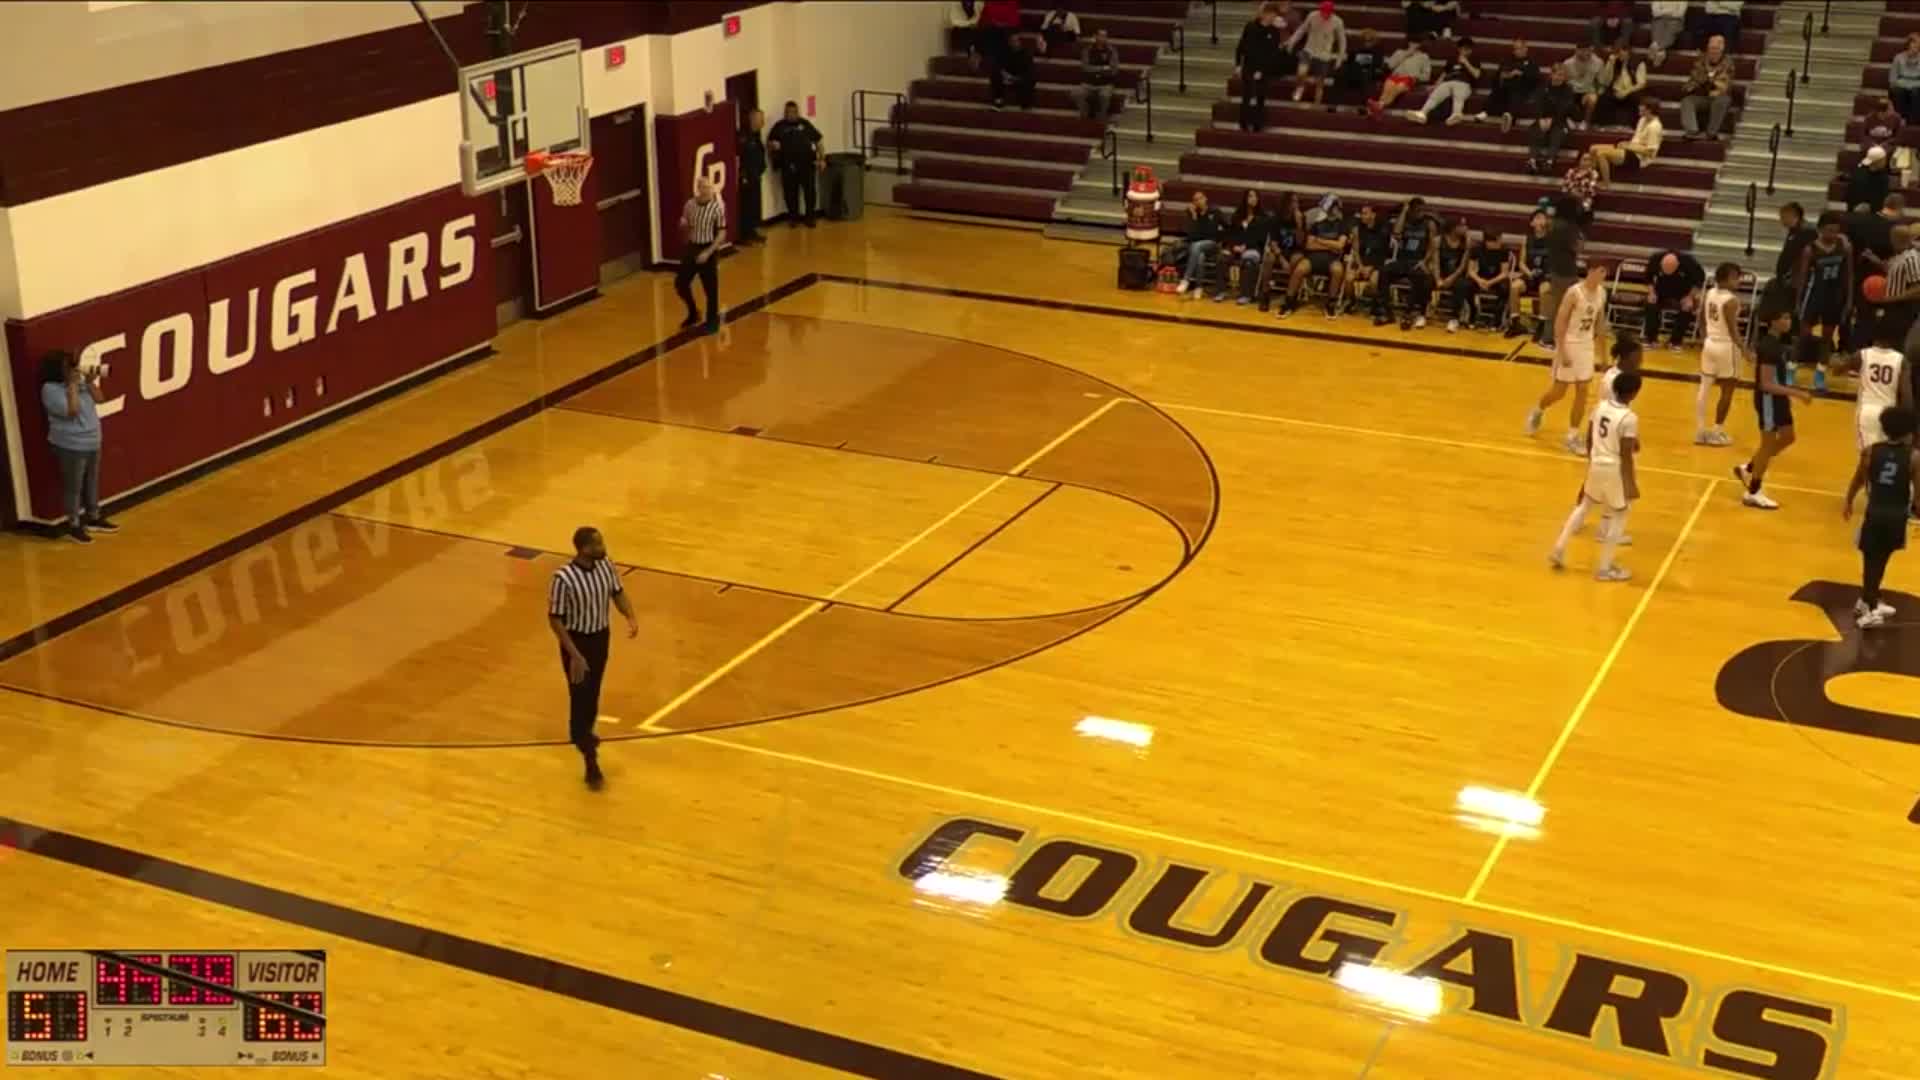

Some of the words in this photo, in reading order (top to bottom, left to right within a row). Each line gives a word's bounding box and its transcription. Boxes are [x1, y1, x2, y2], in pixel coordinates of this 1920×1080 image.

[79, 213, 476, 419] COUGARS
[1869, 364, 1893, 384] 30
[1599, 416, 1610, 438] 5
[1880, 462, 1898, 484] 2
[896, 817, 1836, 1080] COUGARS
